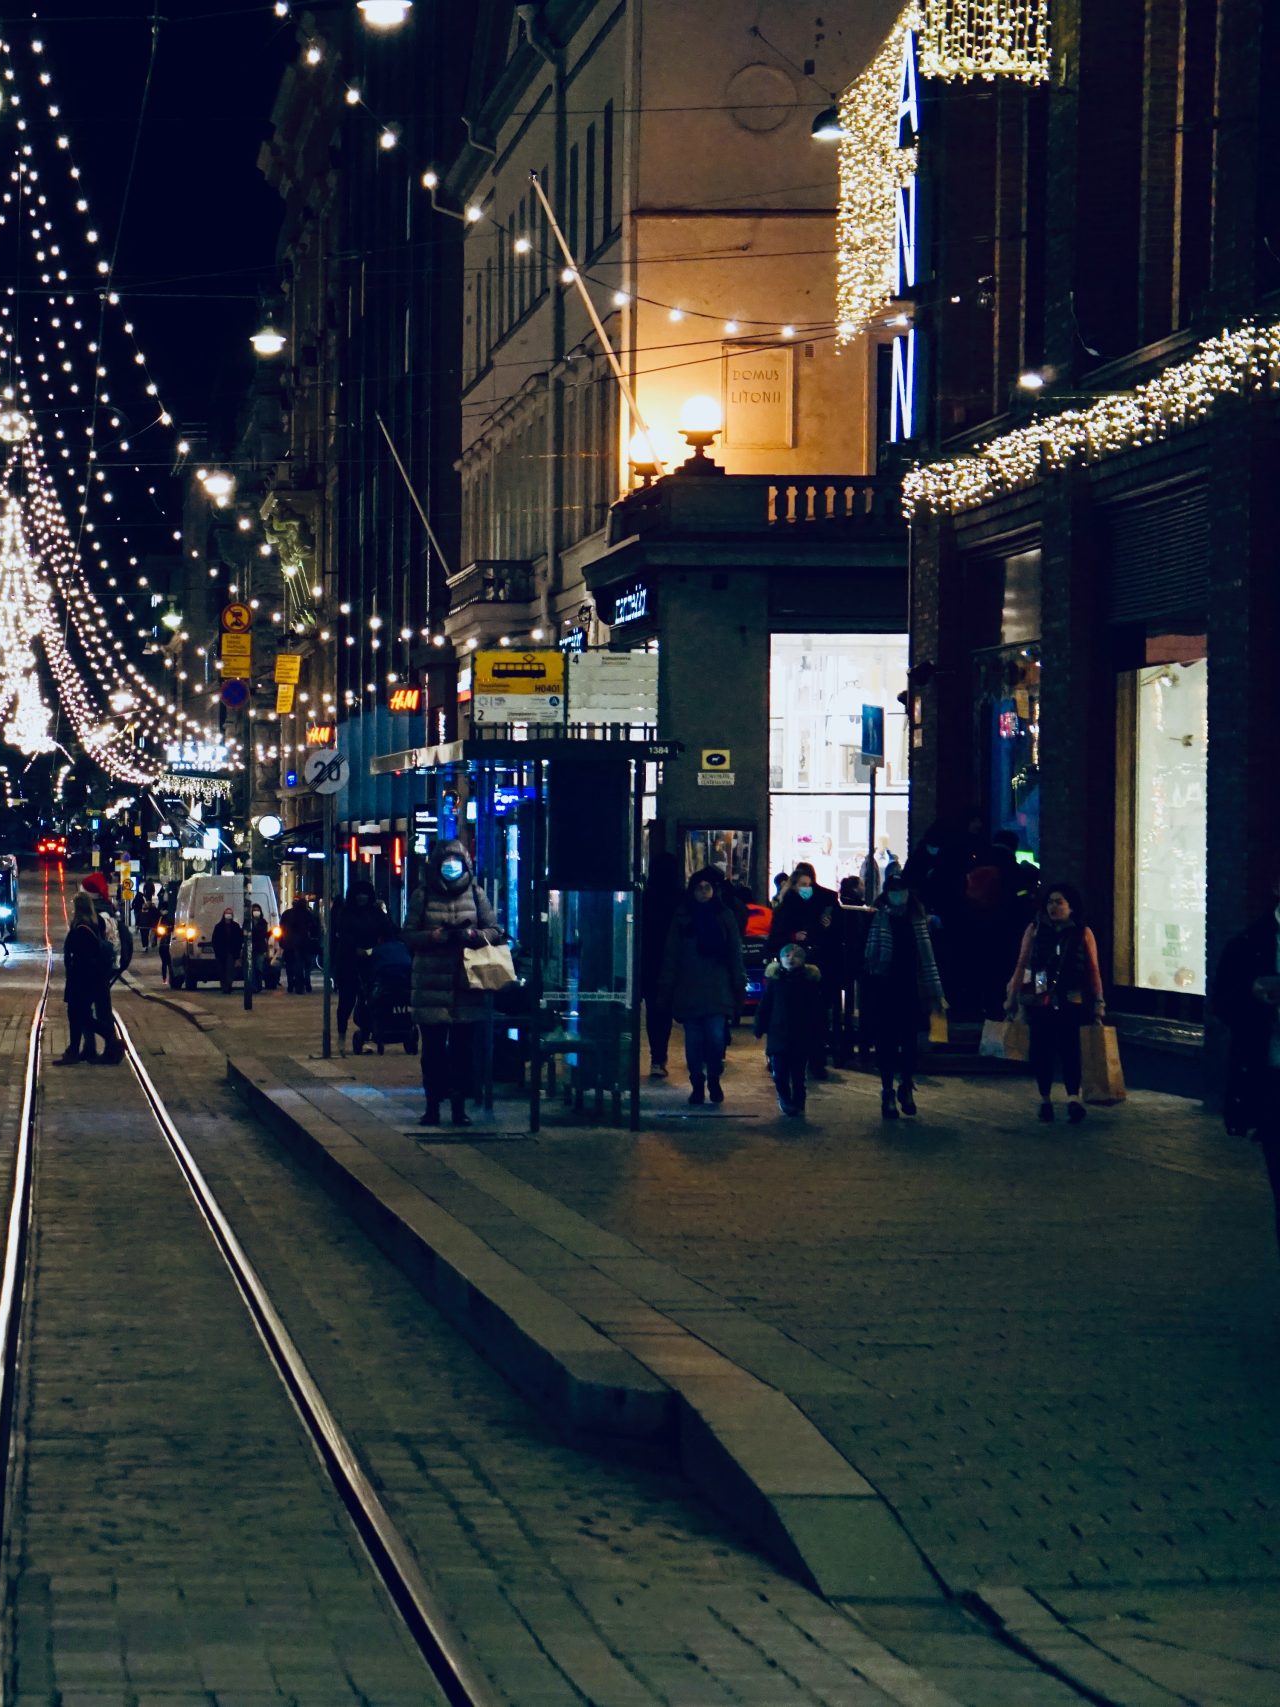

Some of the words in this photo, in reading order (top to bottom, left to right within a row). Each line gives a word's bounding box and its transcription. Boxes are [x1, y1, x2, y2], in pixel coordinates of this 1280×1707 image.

[732, 369, 780, 381] DOMUS
[572, 654, 579, 665] 4
[534, 684, 560, 693] H0401
[390, 690, 419, 711] H&M
[477, 710, 485, 721] 2
[306, 726, 330, 744] H&M
[648, 746, 669, 754] 1384
[314, 761, 341, 781] 20
